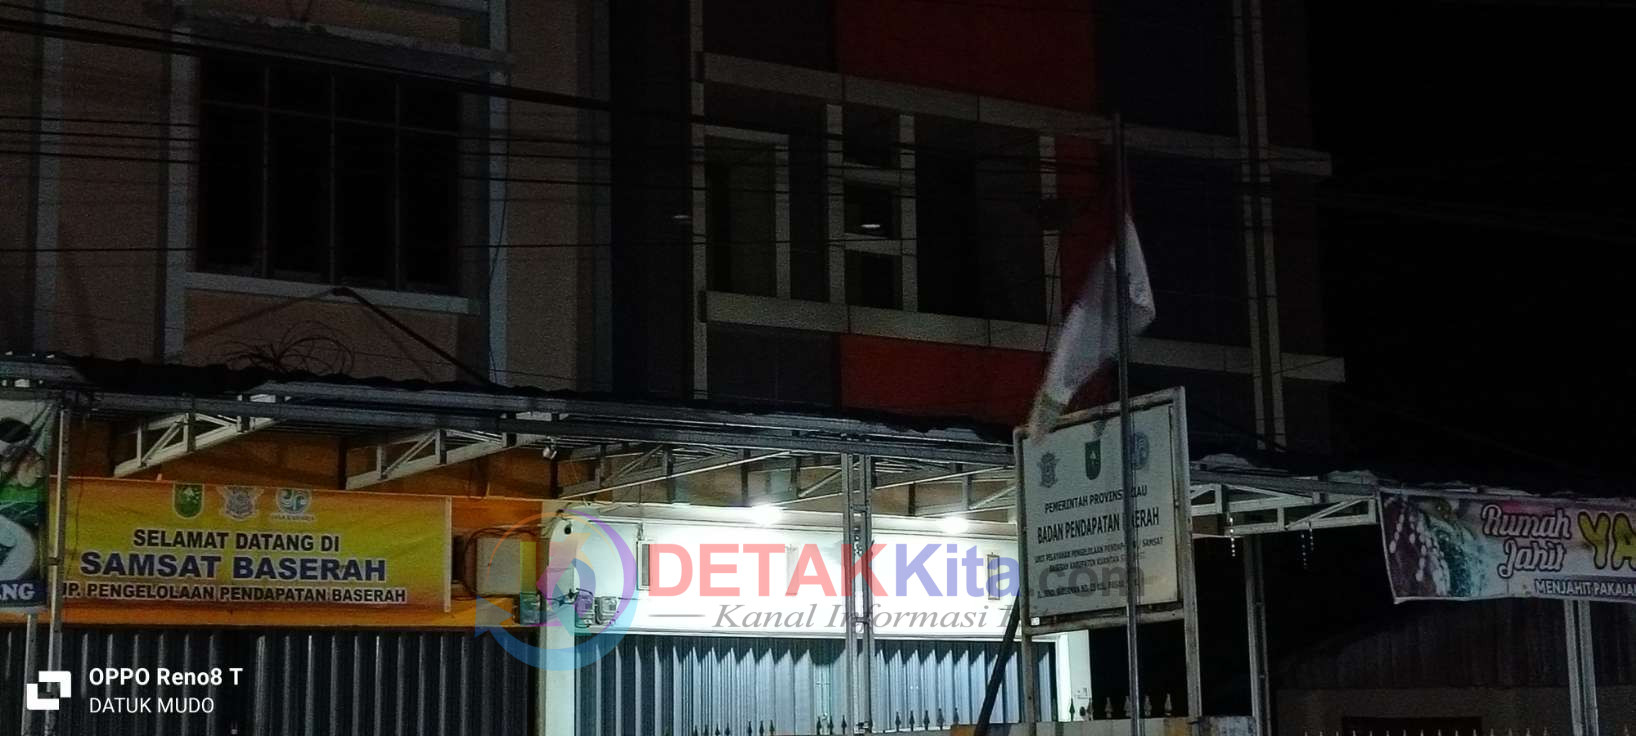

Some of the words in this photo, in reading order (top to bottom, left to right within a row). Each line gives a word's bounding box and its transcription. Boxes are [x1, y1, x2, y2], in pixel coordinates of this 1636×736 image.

[1044, 495, 1088, 514] PEMERINTAH
[1089, 488, 1126, 506] PROVINS
[1037, 522, 1064, 545] BADAN
[1065, 513, 1120, 537] PENDAPATAN
[1481, 503, 1572, 540] Rumah
[133, 528, 229, 550] SELAMAT
[235, 531, 314, 553] DATANG
[320, 533, 340, 553] DI
[79, 551, 221, 580] SAMSAT
[232, 555, 387, 583] BASERAH
[1497, 539, 1567, 579] Jahit
[0, 582, 36, 601] NG
[86, 583, 215, 601] PENGELOLAAN
[219, 586, 328, 603] PENDAPATAN
[331, 588, 407, 604] BASERAH
[1534, 579, 1594, 596] MENJAHIT
